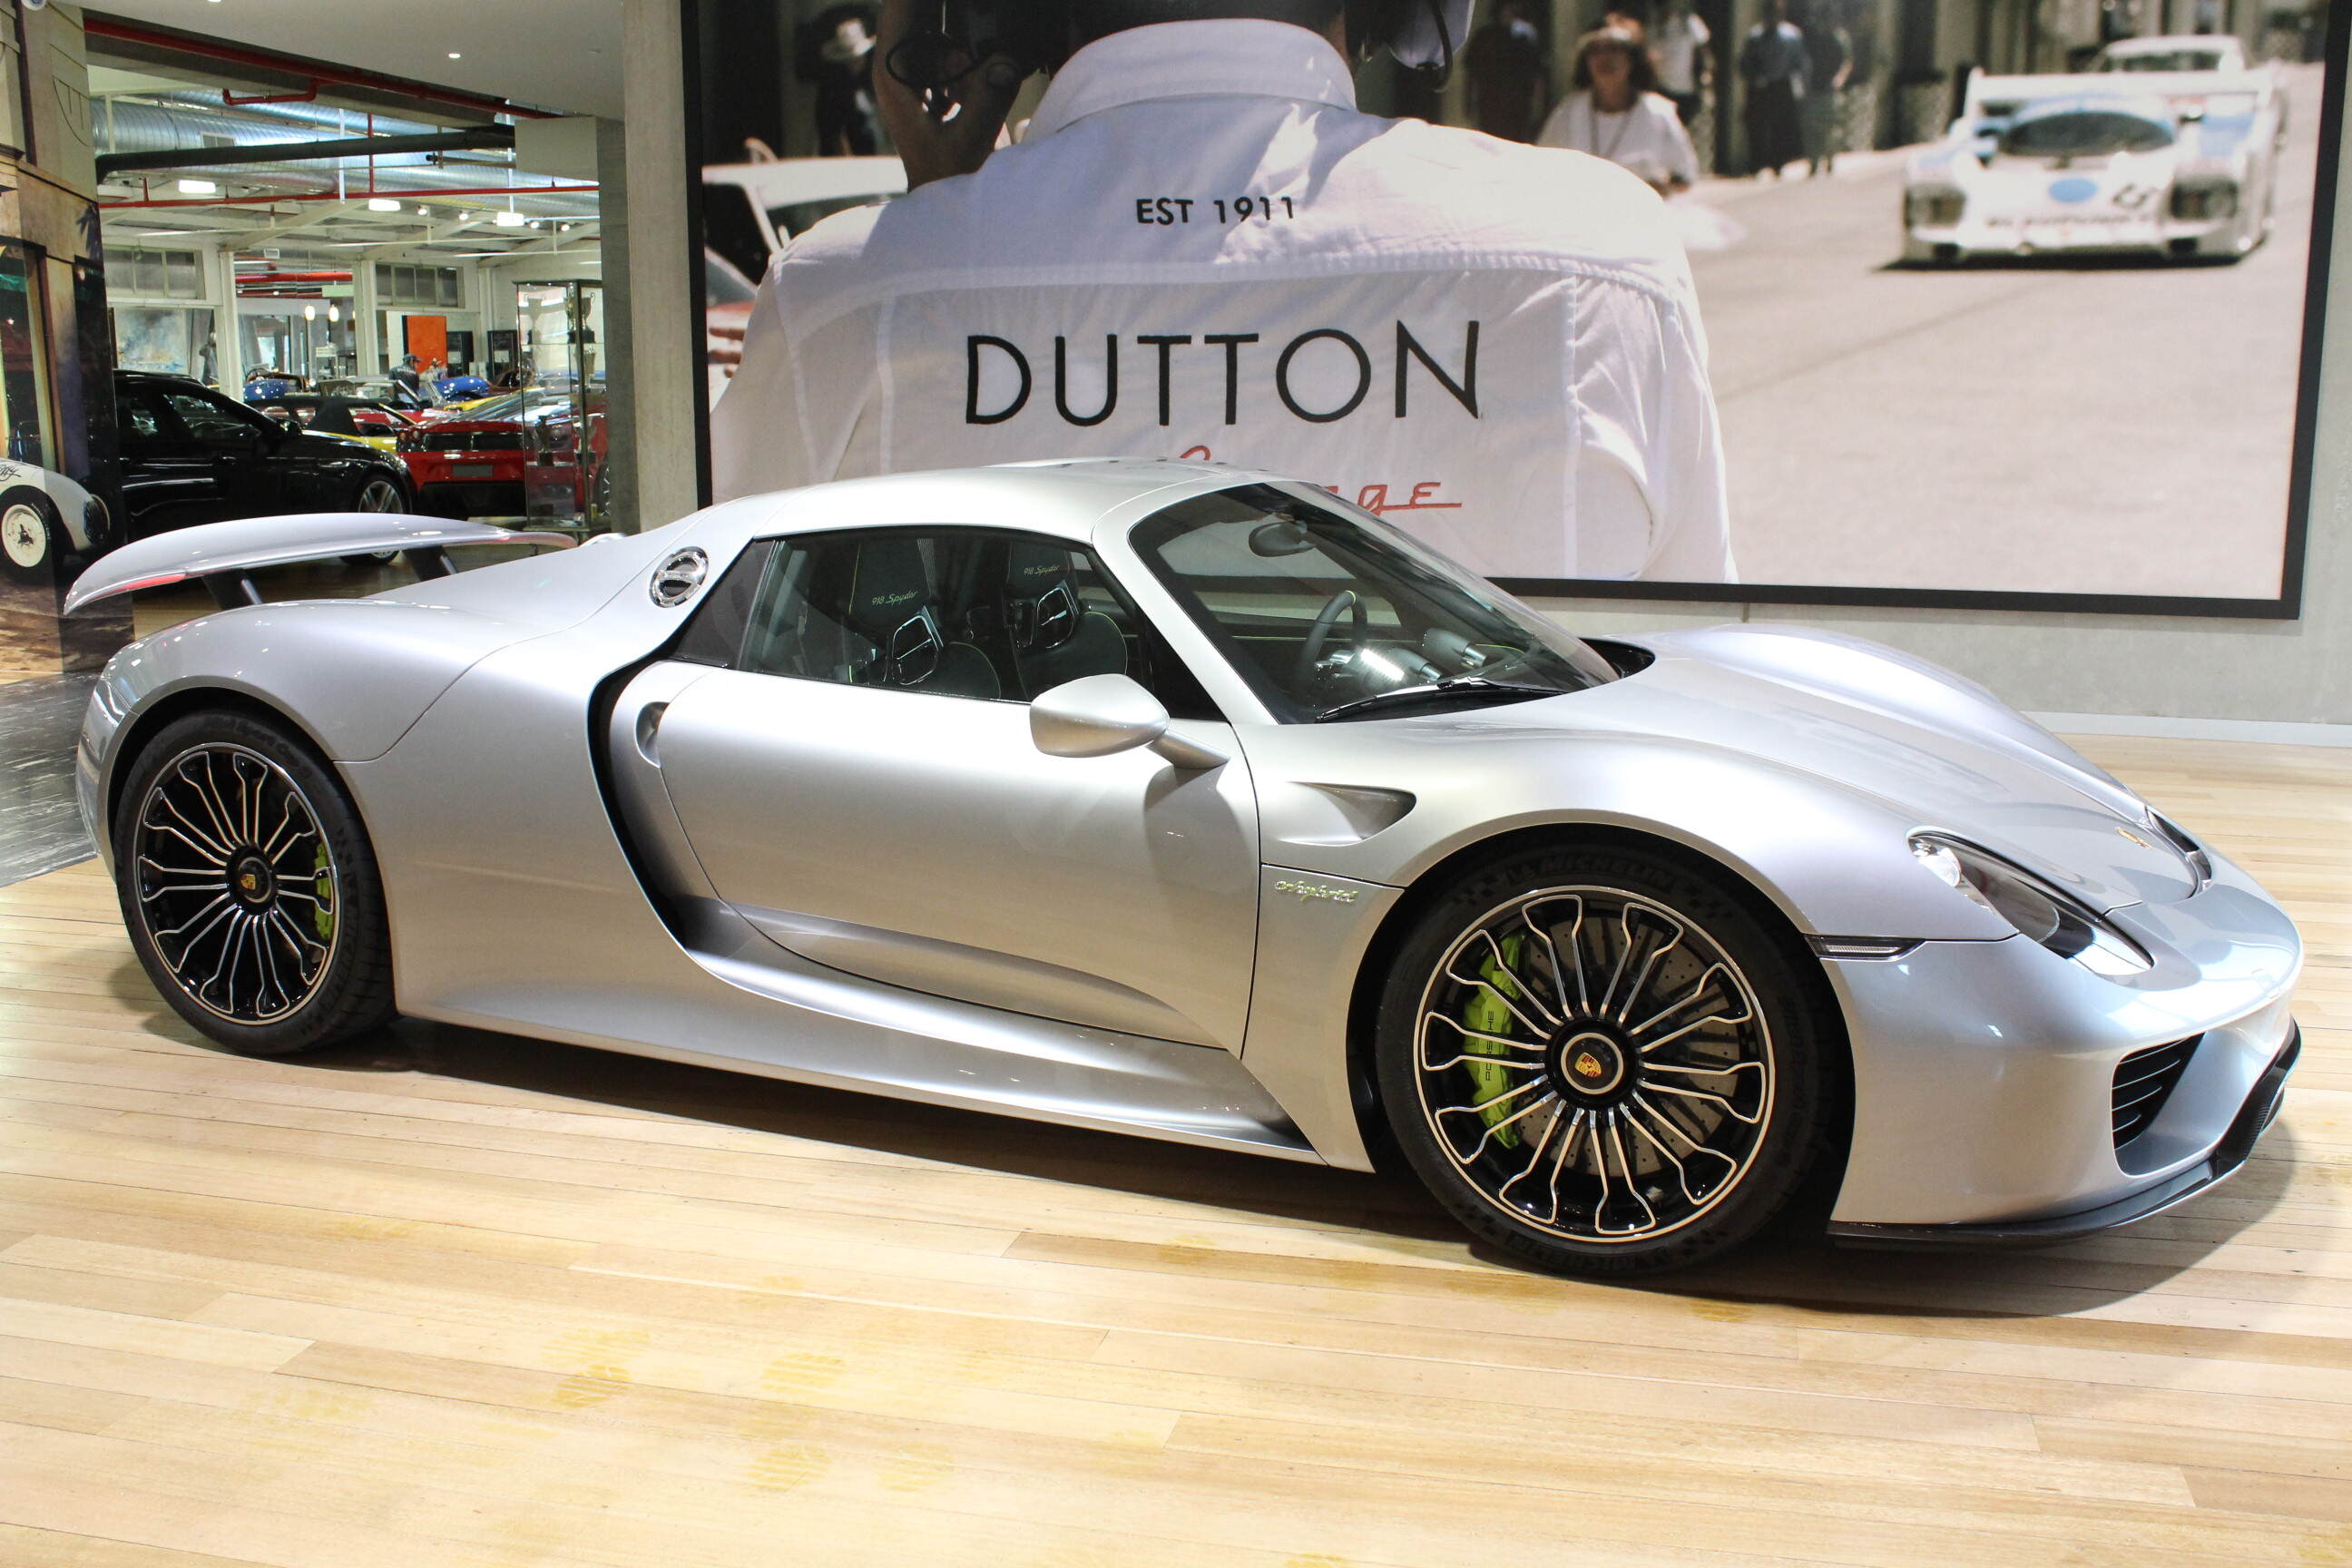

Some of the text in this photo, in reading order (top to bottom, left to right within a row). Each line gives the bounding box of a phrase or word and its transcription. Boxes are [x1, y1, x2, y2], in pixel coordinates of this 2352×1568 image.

[1136, 196, 1293, 225] EST 1911
[965, 320, 1480, 426] DUTTON
[872, 590, 918, 607] 918 Spyder
[1485, 1010, 1494, 1081] POSHE
